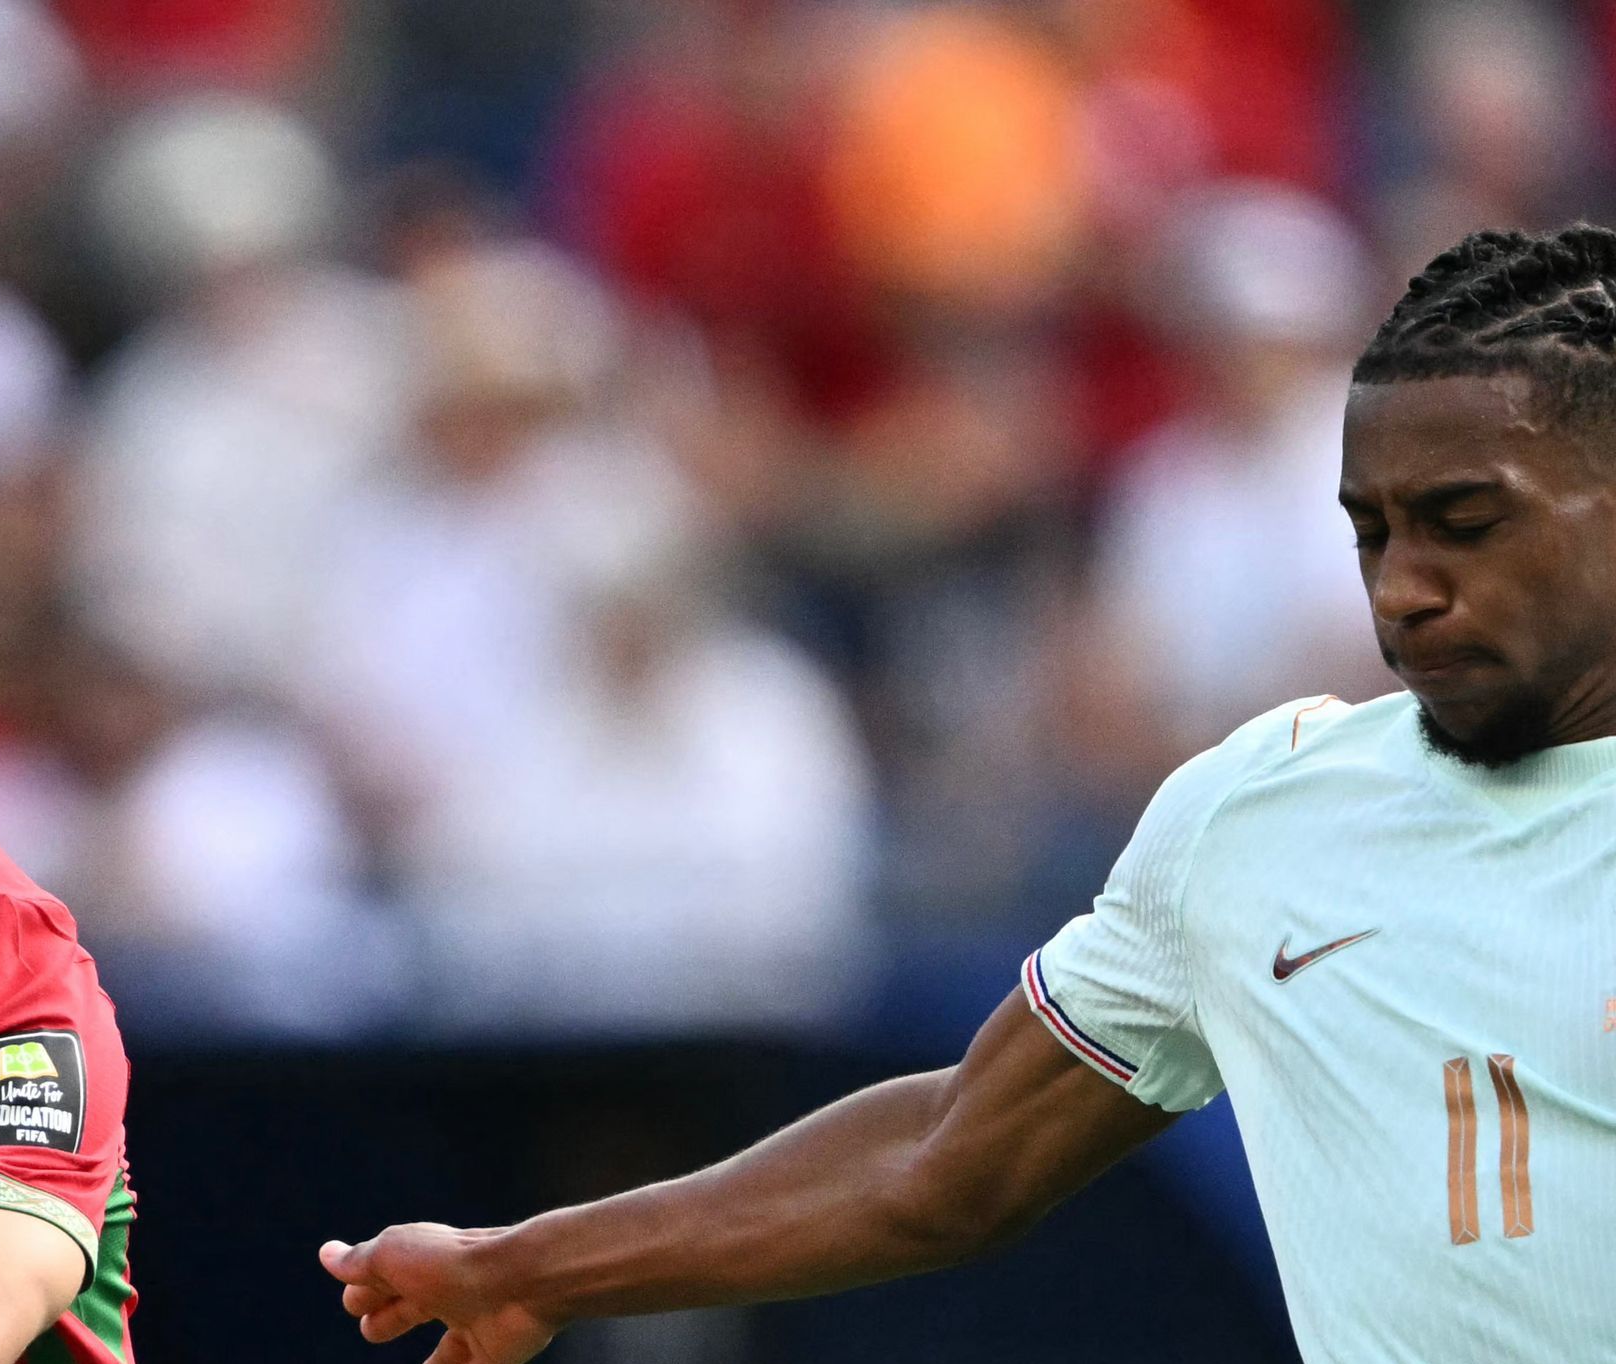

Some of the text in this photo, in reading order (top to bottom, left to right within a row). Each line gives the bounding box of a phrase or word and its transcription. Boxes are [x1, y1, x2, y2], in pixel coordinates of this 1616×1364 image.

[0, 1080, 64, 1104] Unite For
[1443, 1053, 1535, 1245] 11
